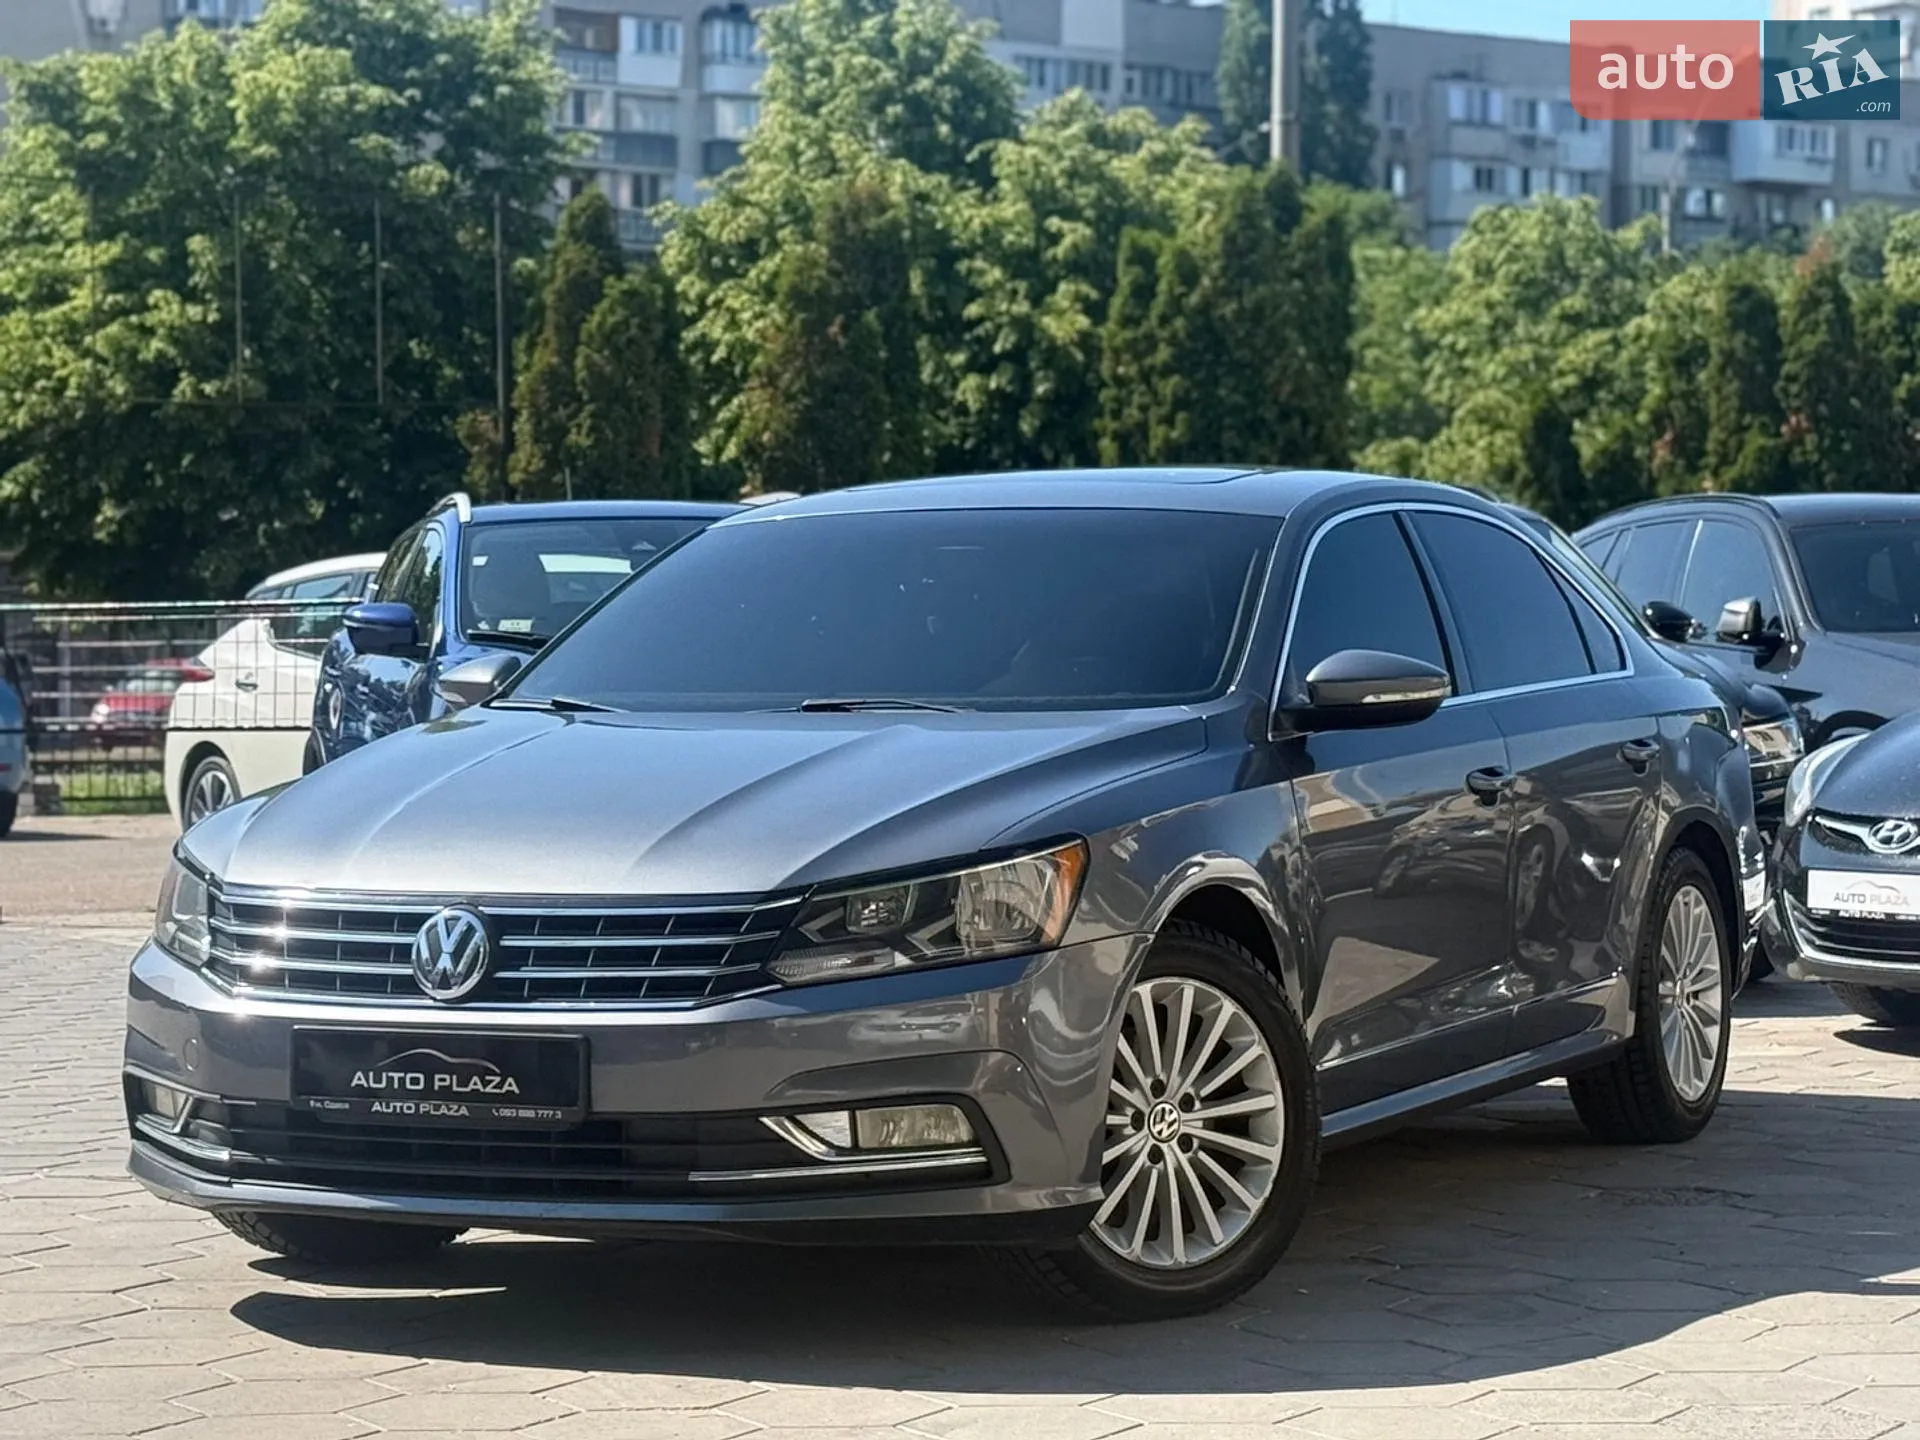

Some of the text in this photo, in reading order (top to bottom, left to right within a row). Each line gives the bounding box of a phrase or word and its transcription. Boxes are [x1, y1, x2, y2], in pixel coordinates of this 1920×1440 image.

[1833, 892, 1909, 906] AUTO PLAZA
[350, 1070, 520, 1094] AUTO PLAZA
[370, 1102, 469, 1116] AUTO PLAZA
